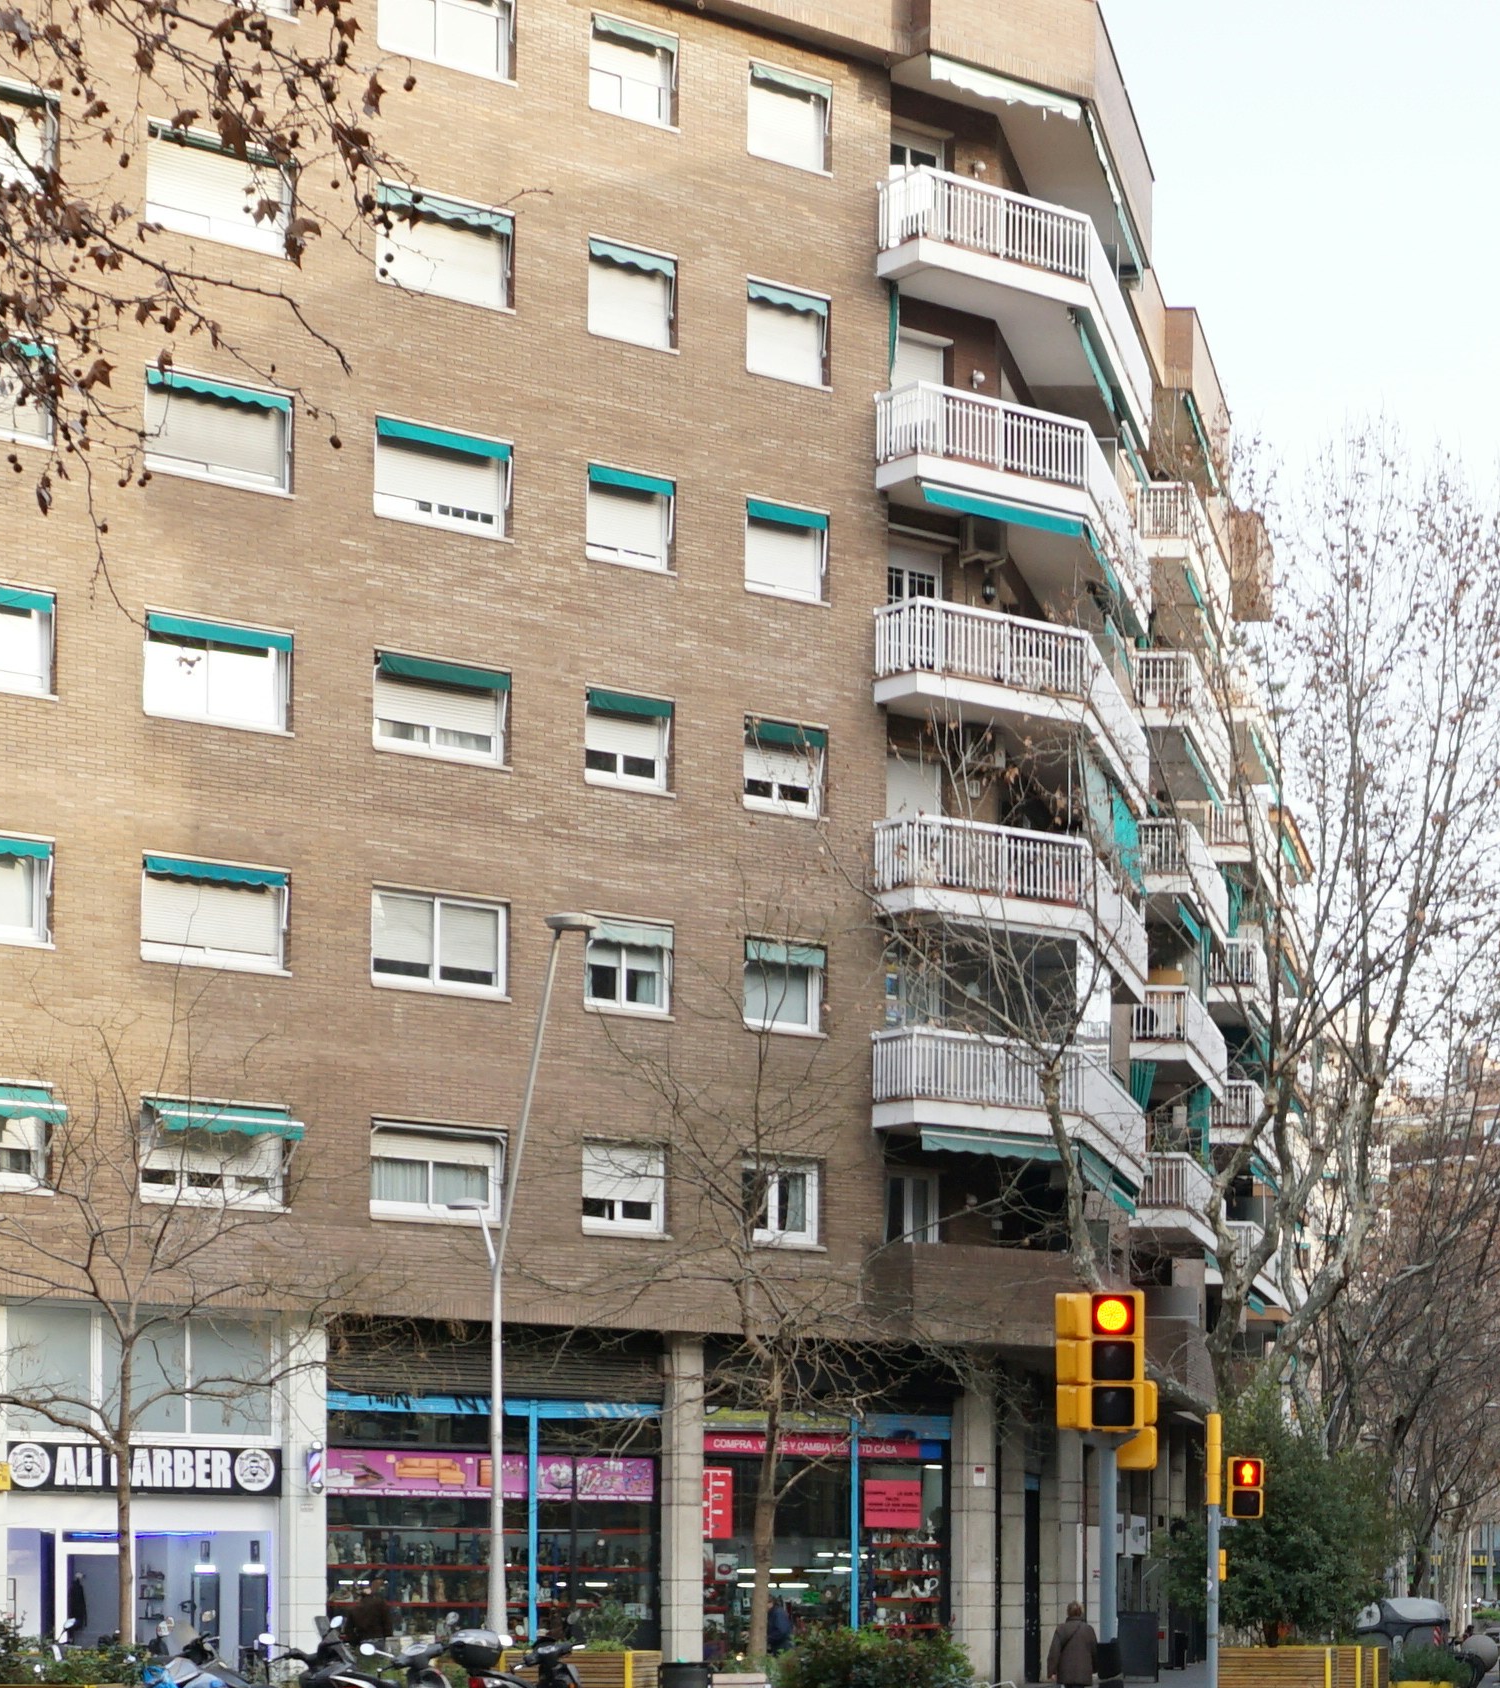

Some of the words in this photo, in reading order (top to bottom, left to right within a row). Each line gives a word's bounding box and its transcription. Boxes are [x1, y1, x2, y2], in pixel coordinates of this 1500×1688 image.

[797, 1441, 830, 1451] CAMBIA
[873, 1444, 897, 1454] CASA
[54, 1446, 103, 1486] ALI
